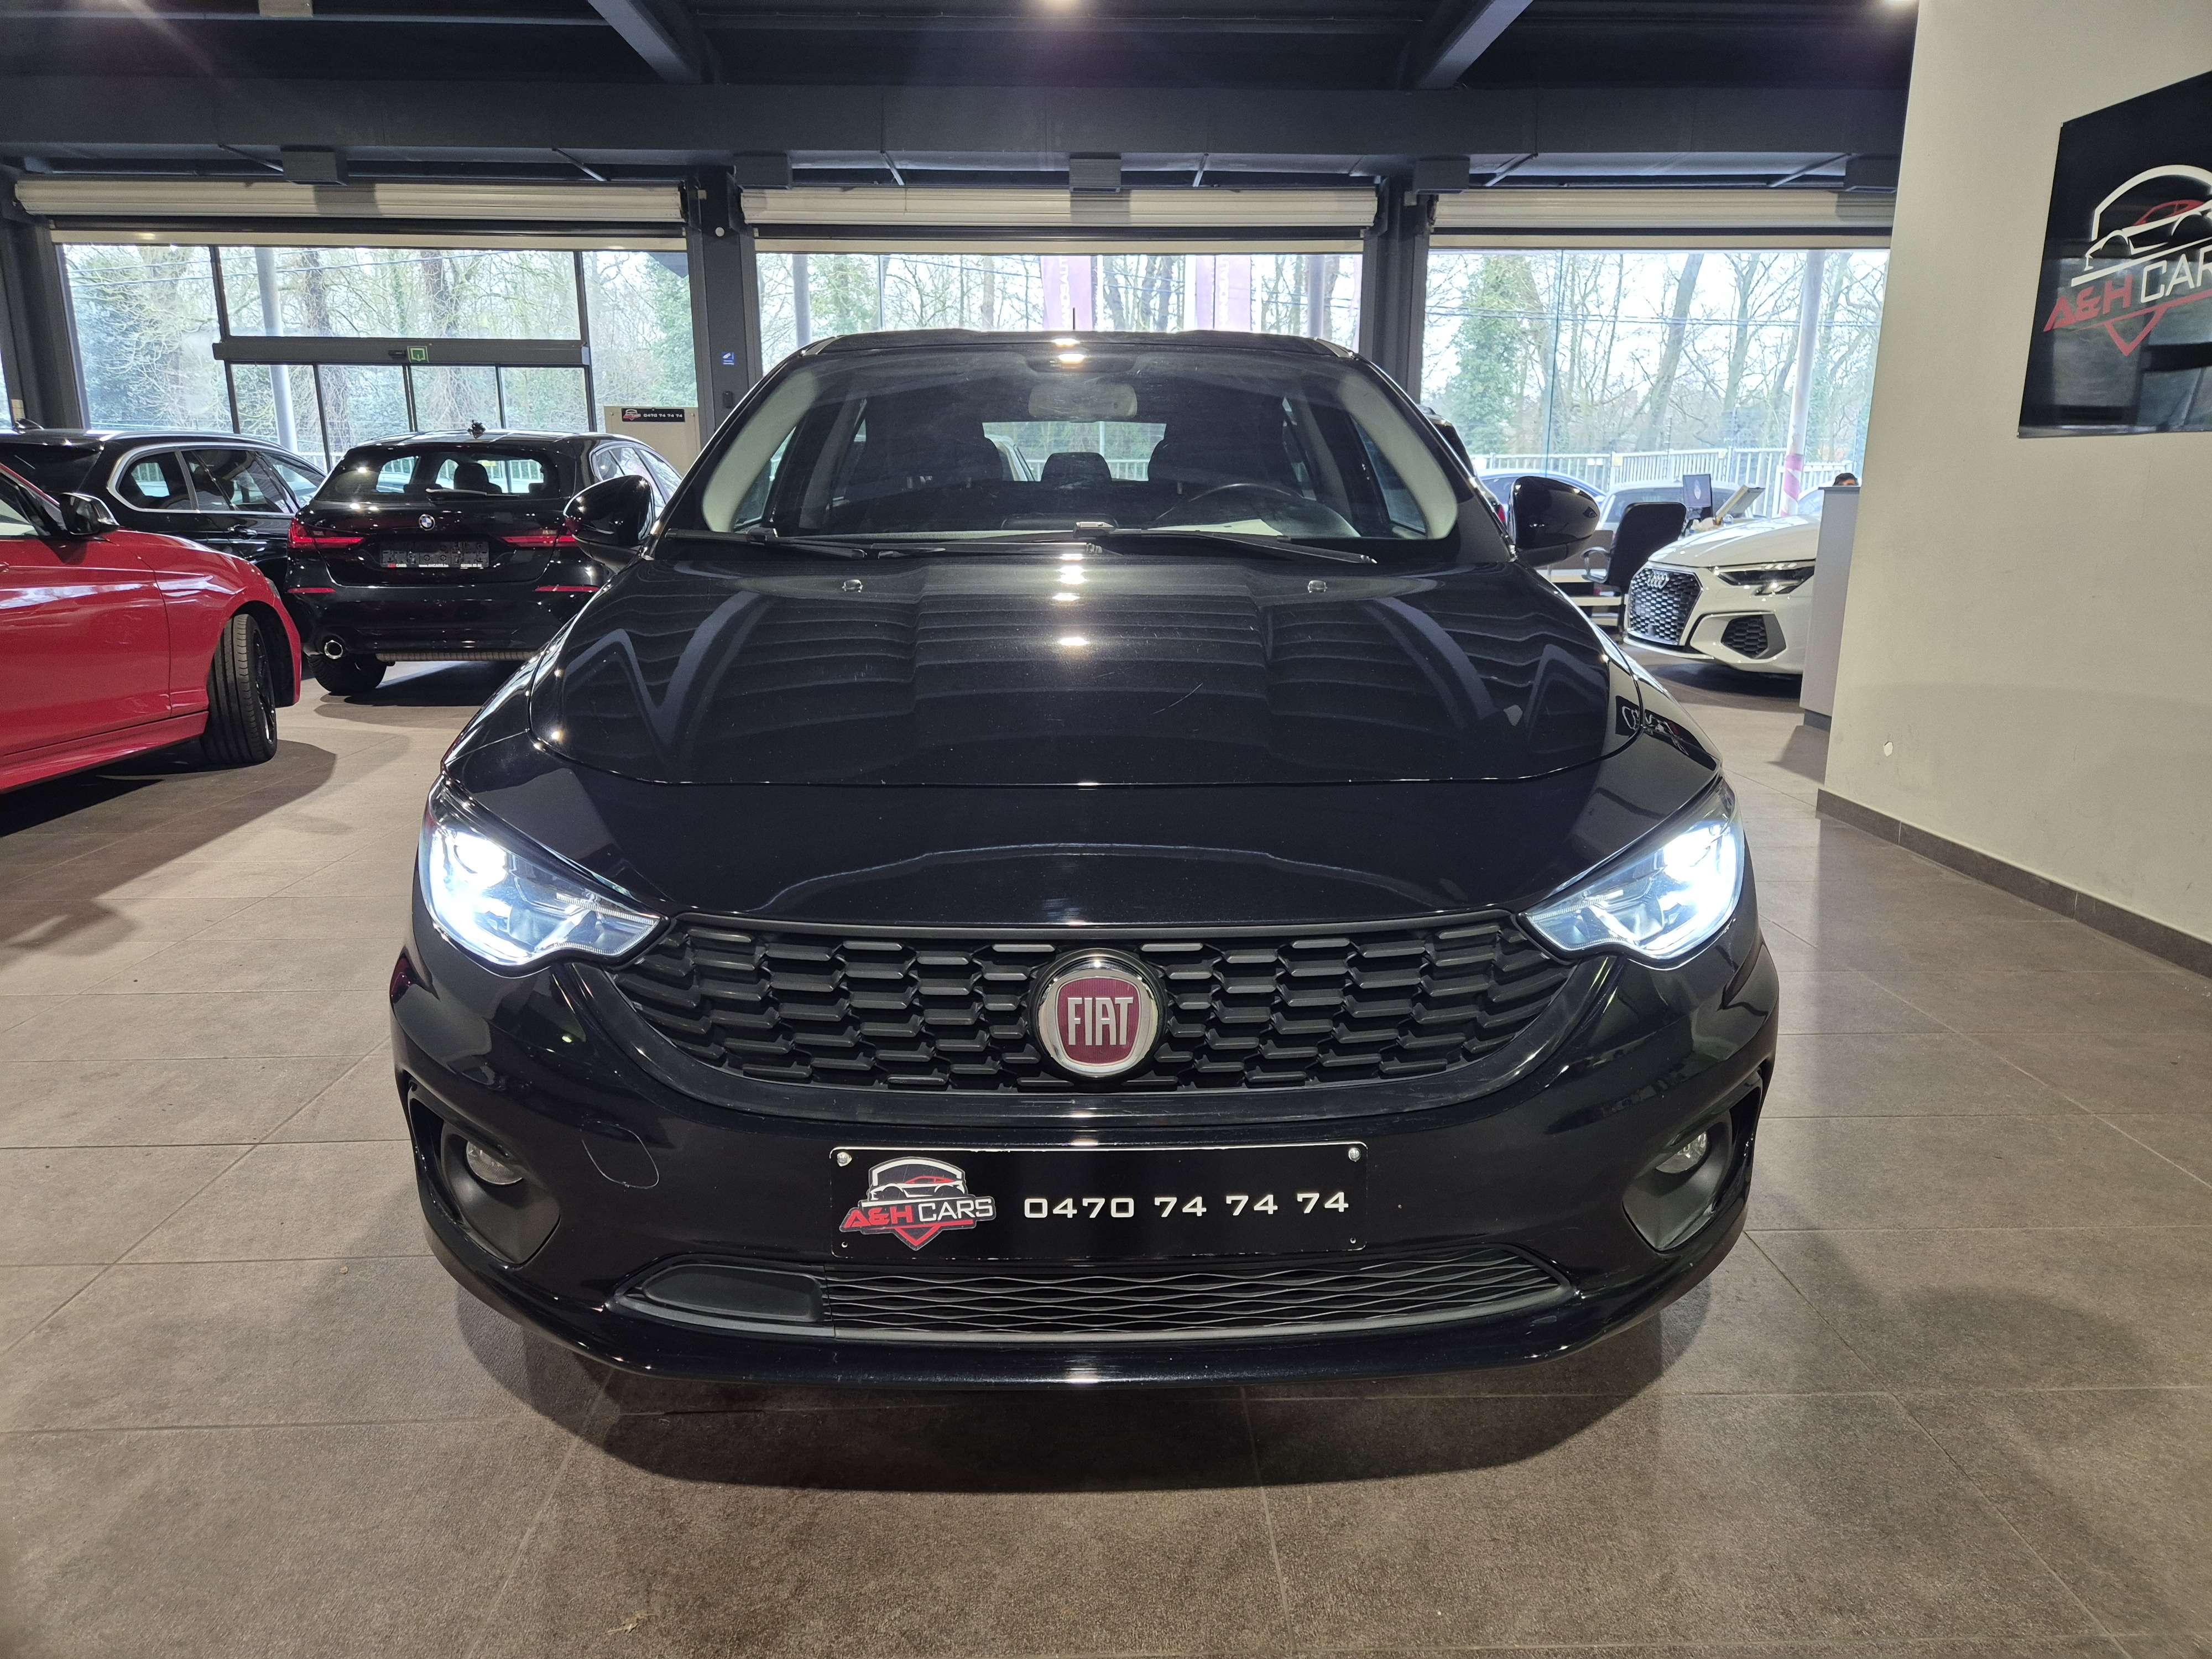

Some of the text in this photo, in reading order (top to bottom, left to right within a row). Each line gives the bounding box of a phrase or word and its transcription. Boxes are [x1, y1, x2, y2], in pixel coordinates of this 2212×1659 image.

[2043, 274, 2133, 332] A&H
[1067, 997, 1134, 1046] FIAT
[844, 1198, 993, 1229] A&H CARS
[1024, 1192, 1349, 1218] 0470 74 74 74
